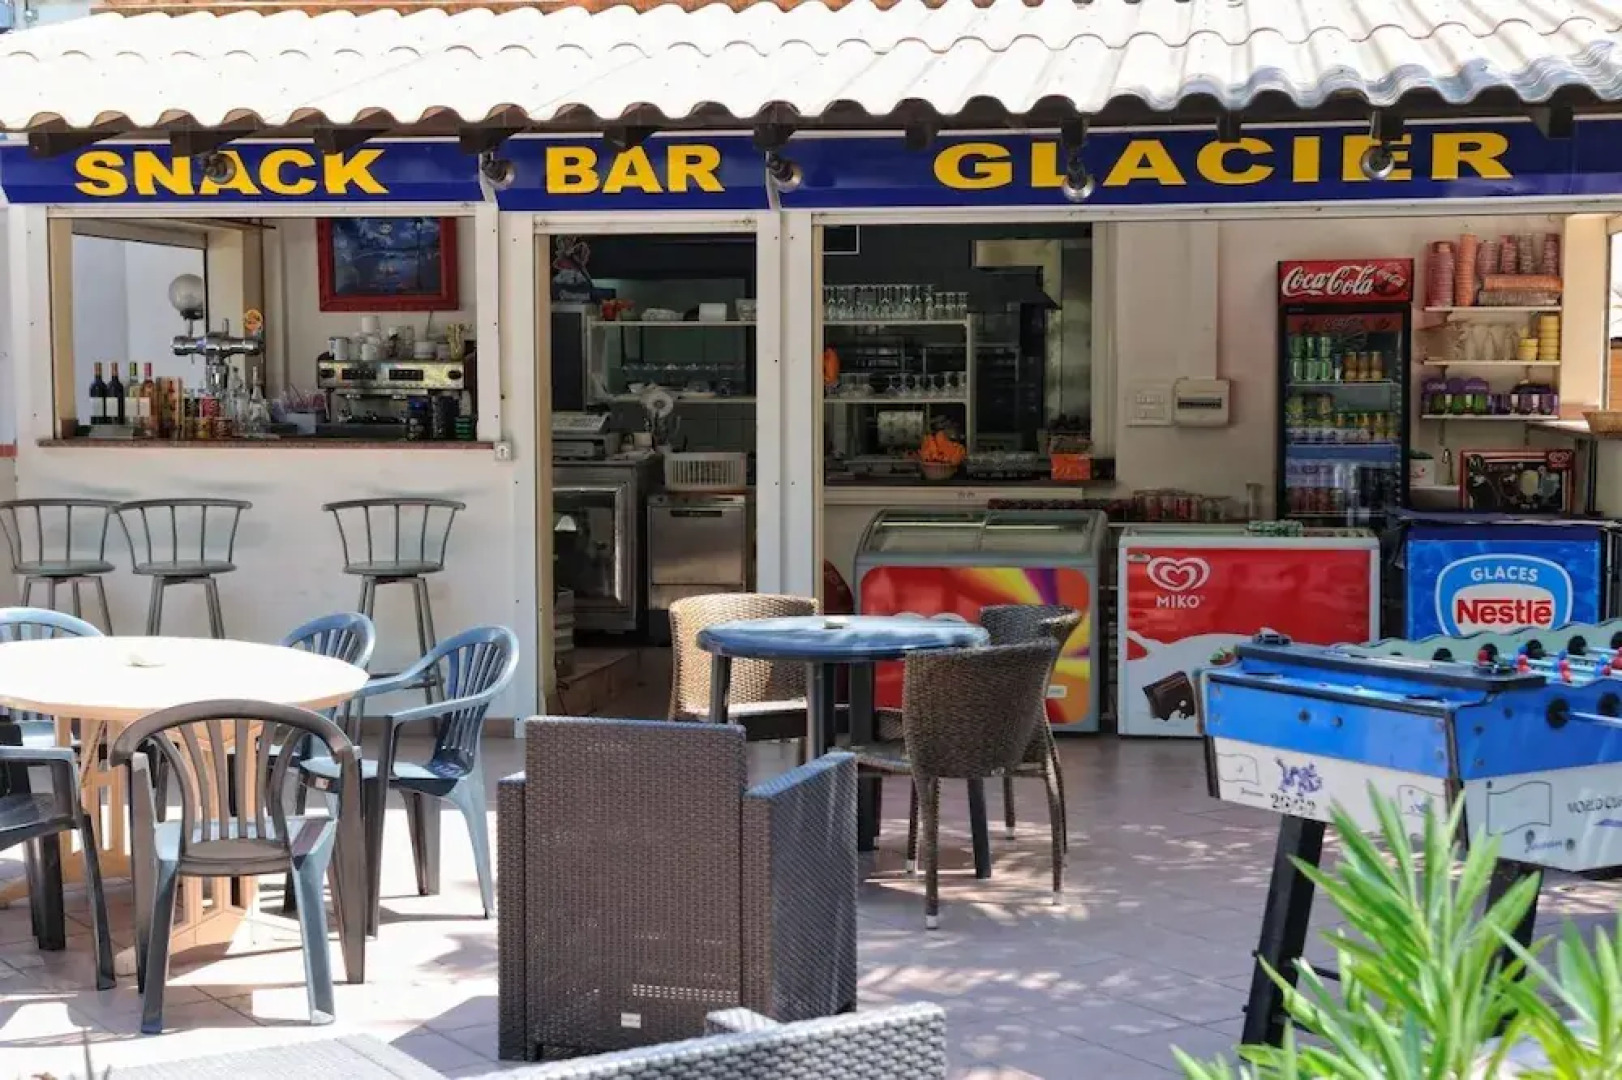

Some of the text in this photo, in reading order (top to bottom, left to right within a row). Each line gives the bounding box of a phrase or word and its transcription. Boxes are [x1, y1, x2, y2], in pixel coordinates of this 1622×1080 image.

[74, 131, 1513, 195] SNACK BAR GLACIER
[1470, 565, 1539, 583] GLACES
[1156, 594, 1201, 609] MIKO
